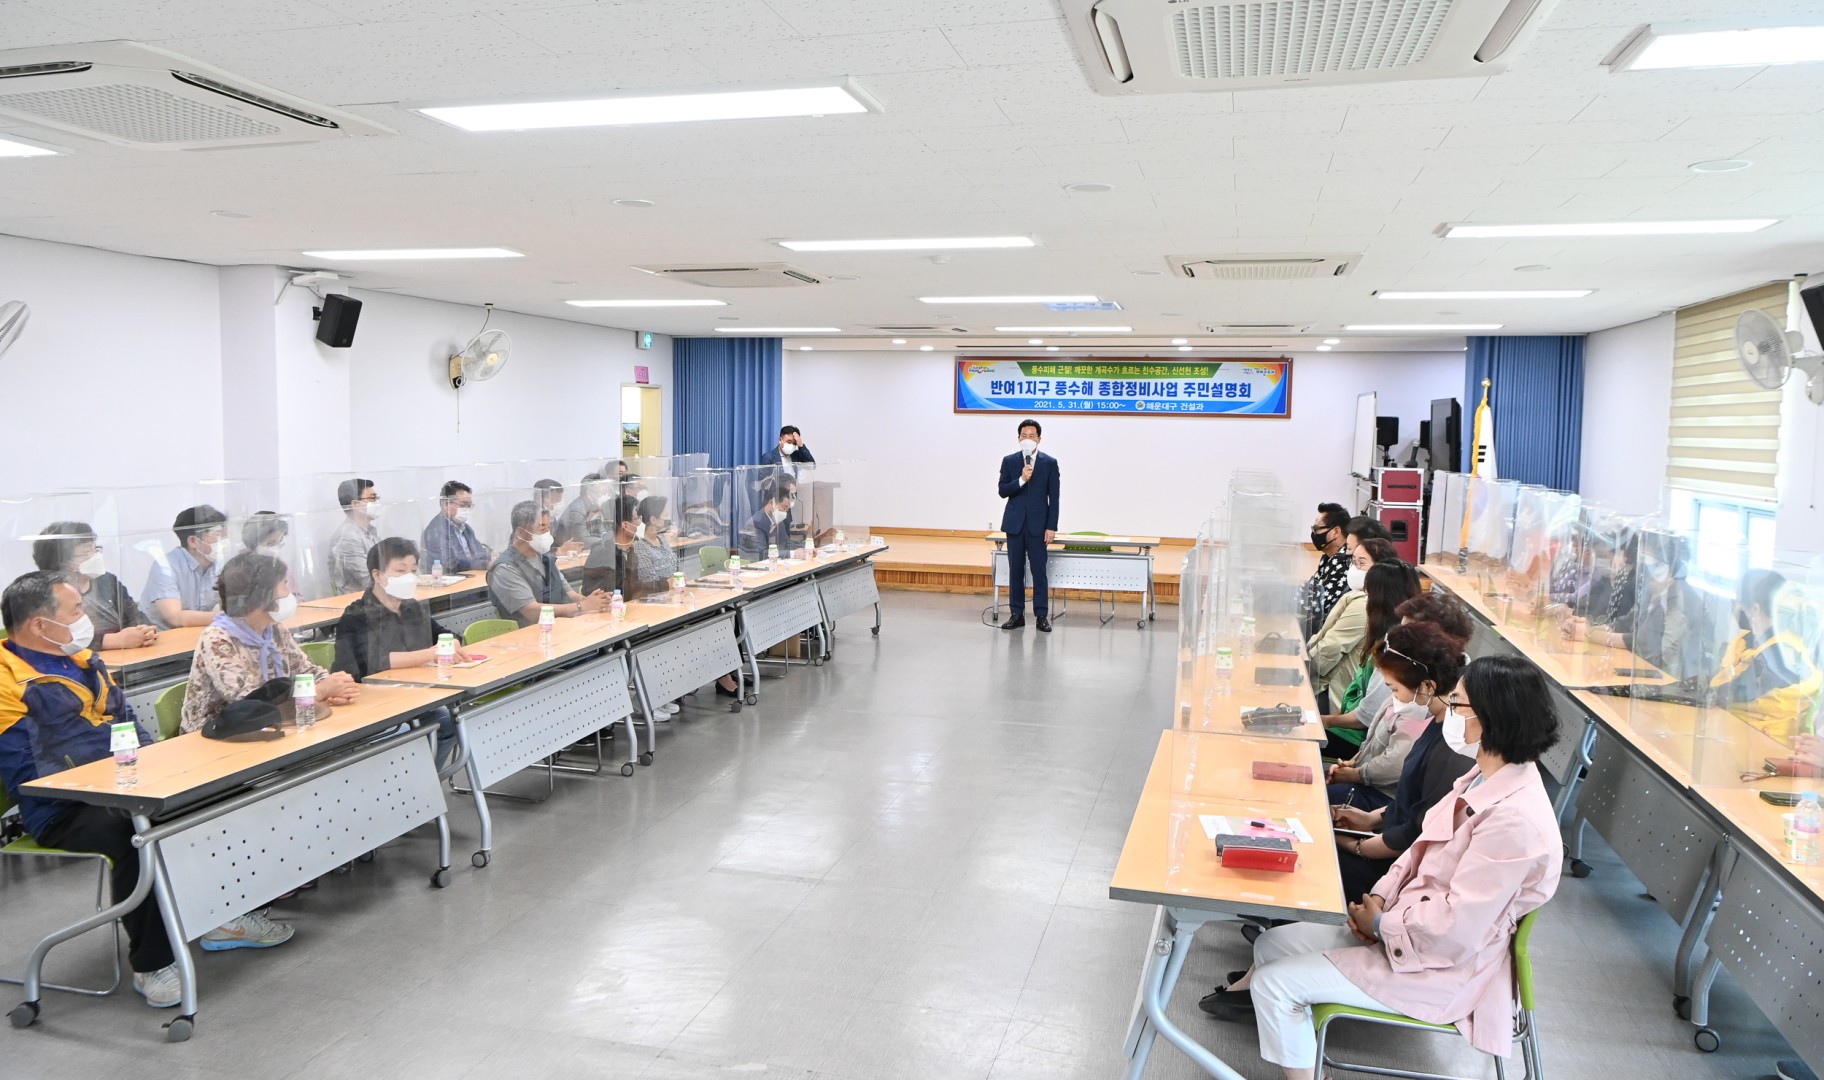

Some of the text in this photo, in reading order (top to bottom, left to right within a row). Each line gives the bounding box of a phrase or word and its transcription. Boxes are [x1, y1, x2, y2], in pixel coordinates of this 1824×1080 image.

[990, 380, 1251, 398] 반여1지구 풍수해 종합정비사업 주민설명회
[1146, 402, 1204, 411] 해운대구 건설과
